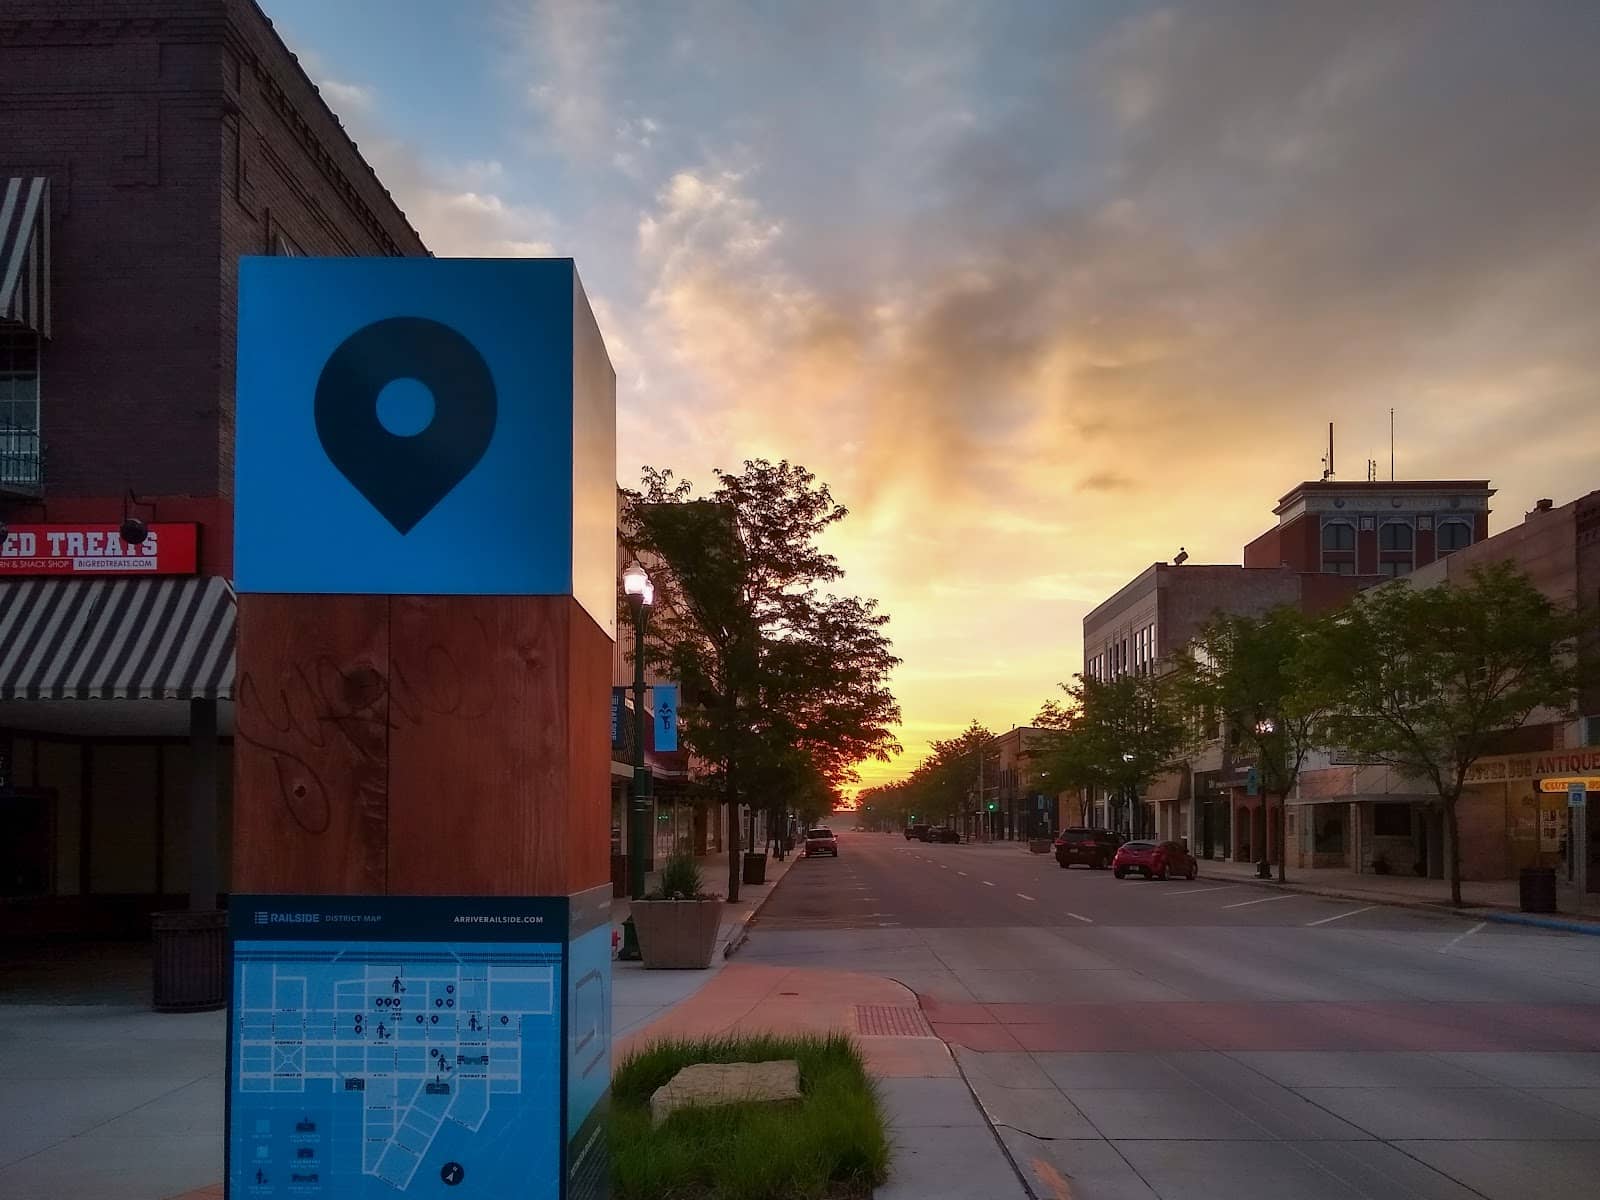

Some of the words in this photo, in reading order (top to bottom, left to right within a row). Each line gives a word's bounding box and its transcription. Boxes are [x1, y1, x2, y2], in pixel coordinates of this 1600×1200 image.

[19, 560, 45, 569] SNACK
[47, 560, 69, 569] SHOP
[78, 560, 152, 568] BIGREDTREATS.COM
[269, 912, 321, 924] RAILSIDE
[325, 914, 362, 922] DISTRICT
[363, 914, 382, 923] MAP
[453, 915, 544, 924] ARRIVERAILSIDE.COM
